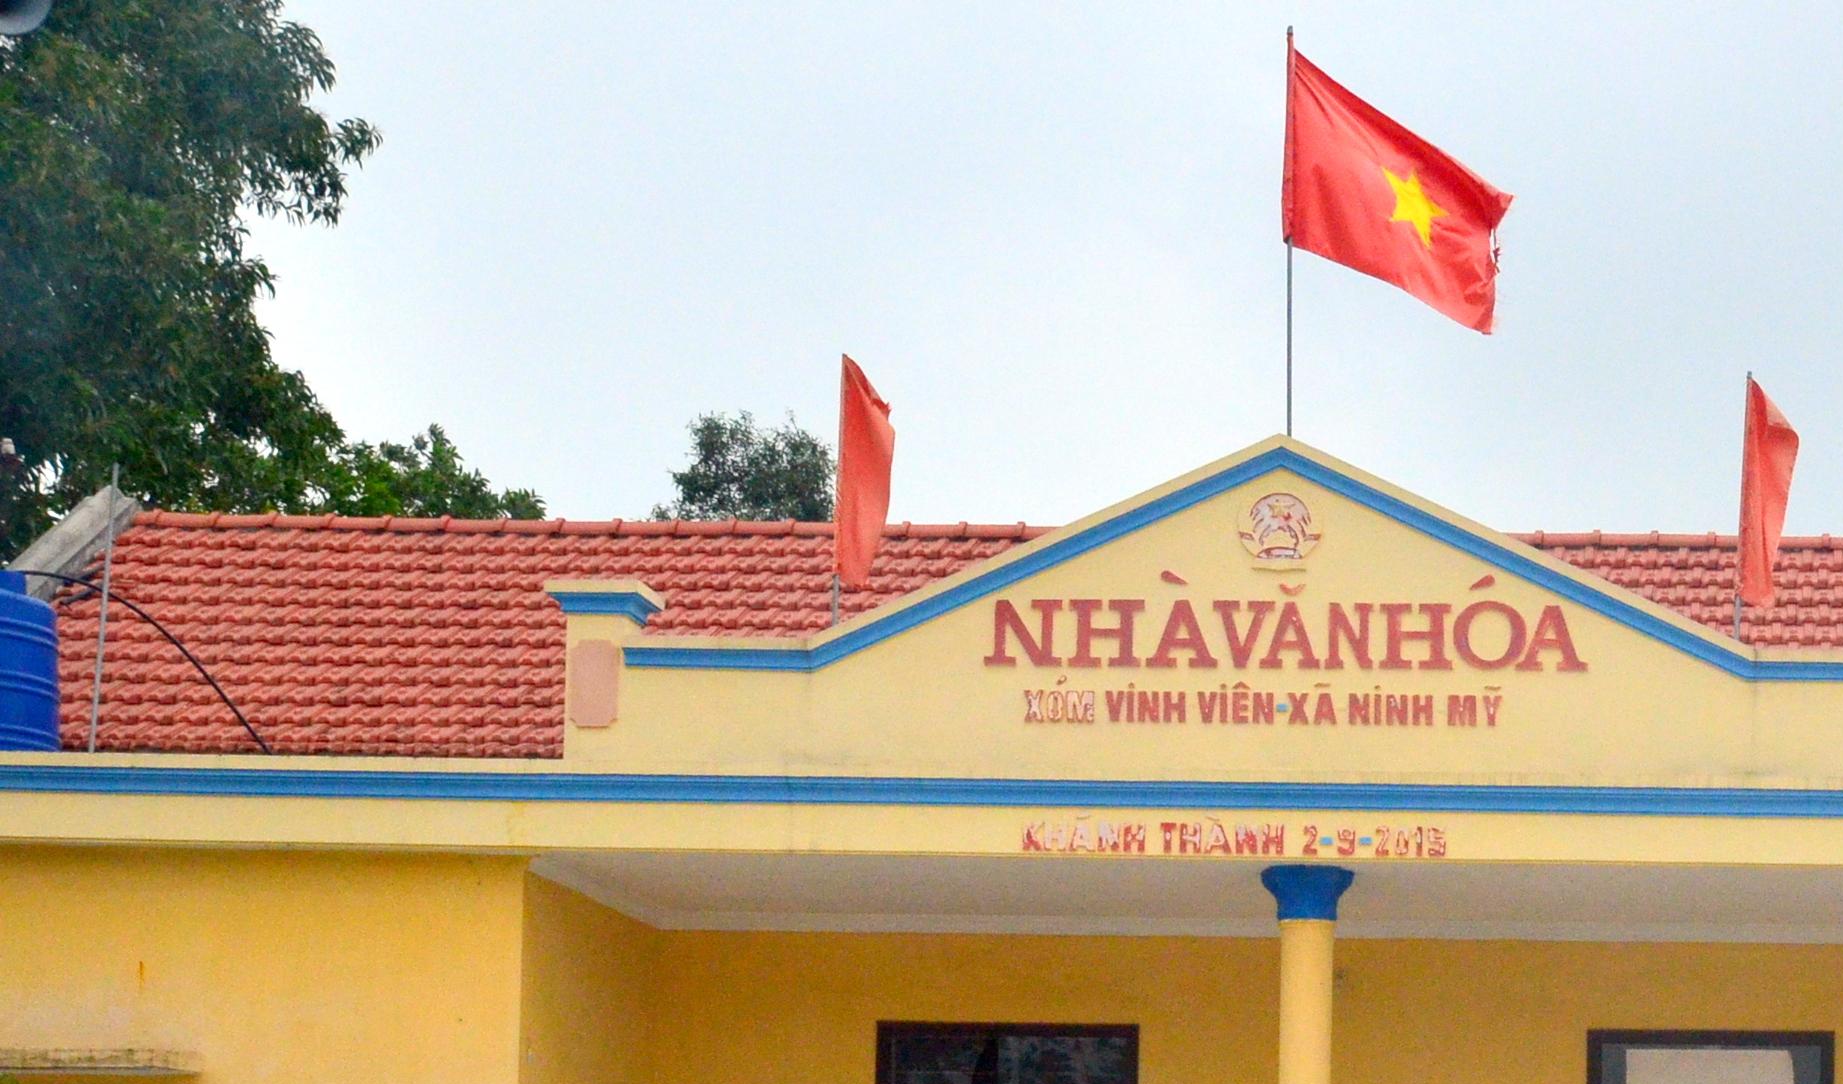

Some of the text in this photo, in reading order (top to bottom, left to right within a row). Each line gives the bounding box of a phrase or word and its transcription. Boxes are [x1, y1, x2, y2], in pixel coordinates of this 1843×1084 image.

[1024, 675, 1095, 724] XÓM
[1447, 685, 1502, 726] MỸ
[1160, 816, 1285, 854] THÀNH
